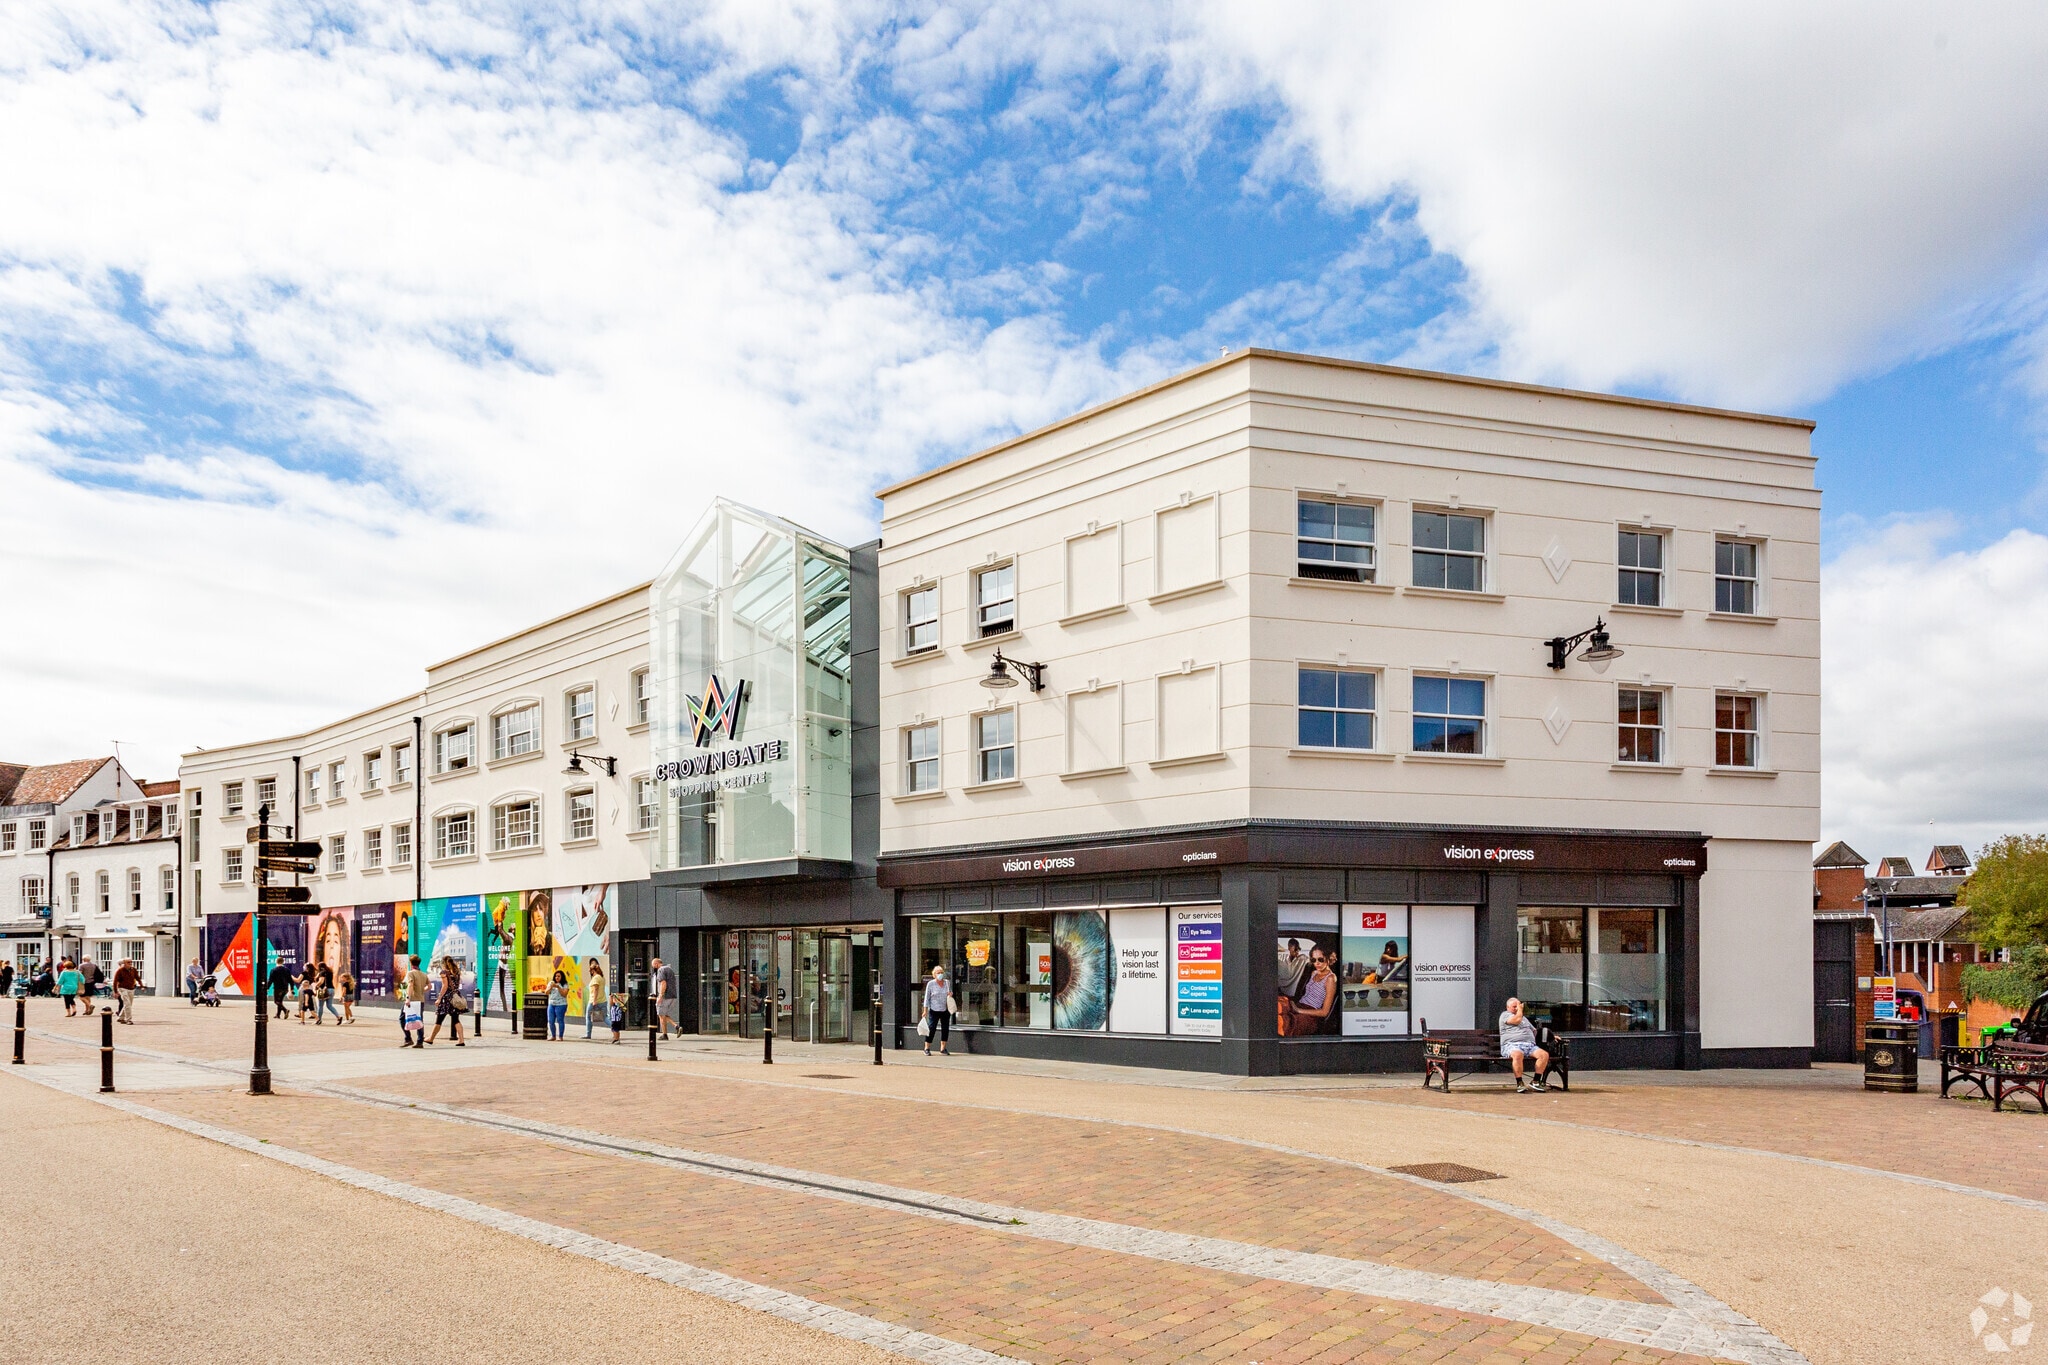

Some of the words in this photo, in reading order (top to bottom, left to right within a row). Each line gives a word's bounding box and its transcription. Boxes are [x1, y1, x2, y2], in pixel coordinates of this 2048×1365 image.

[656, 740, 781, 781] CROWNGATE
[669, 780, 720, 798] SHOPPING
[724, 772, 769, 789] CENTRE
[1182, 851, 1217, 862] opticians
[1443, 845, 1481, 859] vision
[1484, 847, 1534, 862] express
[1002, 859, 1031, 872] vision
[1033, 856, 1075, 871] express
[1663, 857, 1696, 867] opticians
[1192, 912, 1222, 920] services
[1122, 949, 1139, 958] Help
[1142, 950, 1158, 959] your
[1122, 960, 1144, 968] vision
[1145, 960, 1159, 968] last
[1415, 963, 1438, 972] vision
[1440, 964, 1471, 973] express
[1128, 970, 1158, 979] lifetime.
